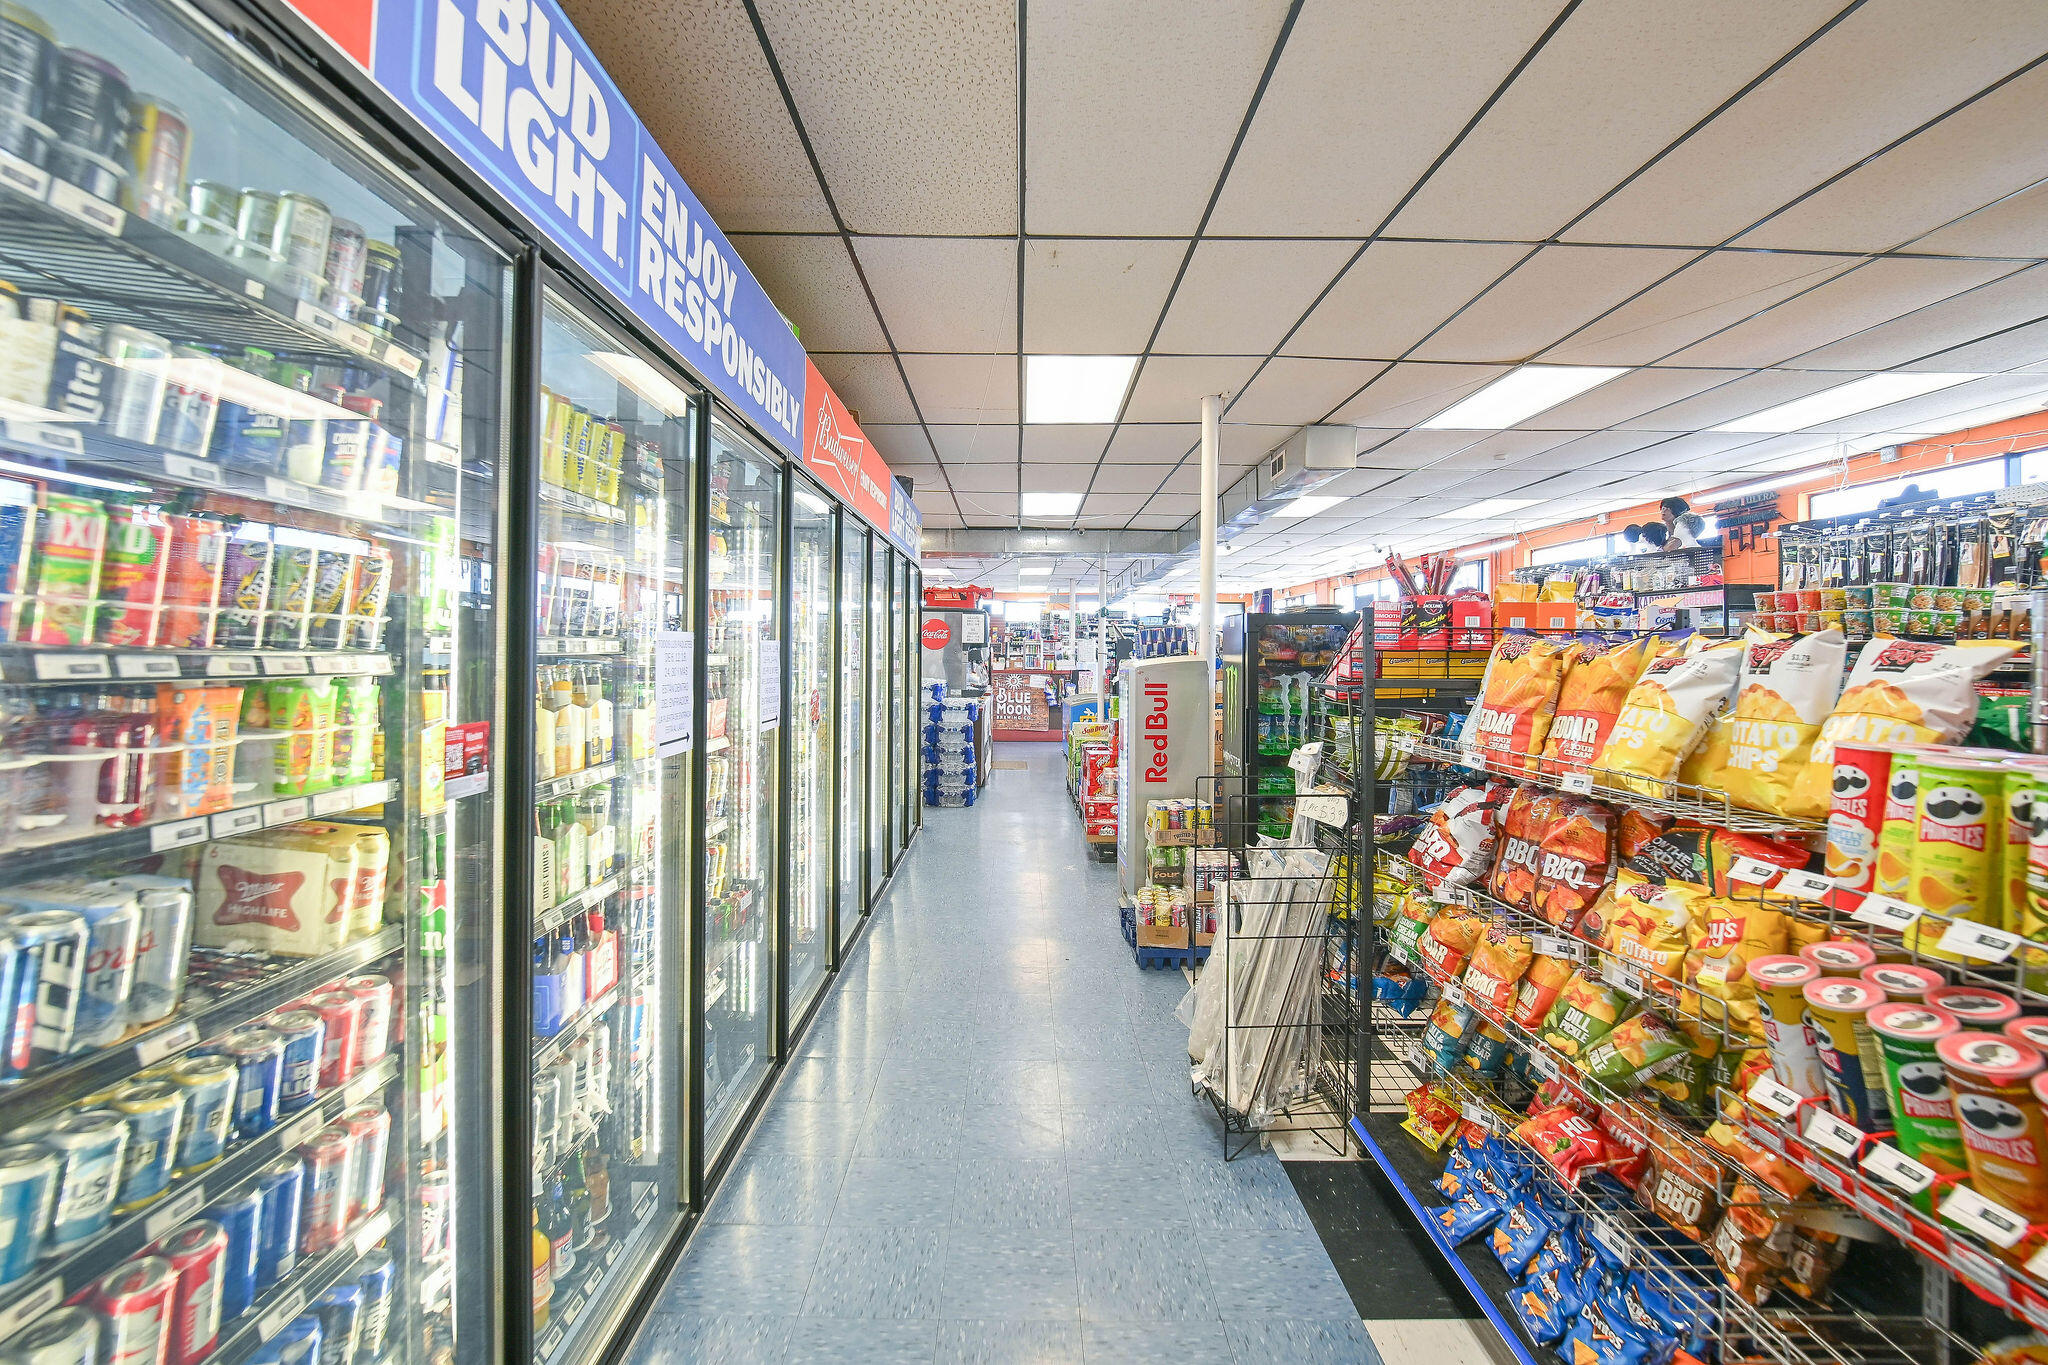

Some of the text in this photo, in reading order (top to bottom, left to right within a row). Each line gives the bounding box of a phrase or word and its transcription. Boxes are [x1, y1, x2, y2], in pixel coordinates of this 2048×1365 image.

[434, 0, 627, 267] LIGHT
[643, 152, 739, 319] ENJOY
[638, 221, 801, 440] RESPONSIBLY
[818, 407, 859, 476] Budweiser
[996, 704, 1032, 716] MOON
[1144, 683, 1169, 783] Red Bull
[1563, 749, 1593, 759] CREAM
[1920, 819, 1985, 850] PRINGLES
[1652, 836, 1670, 849] ON
[1667, 842, 1693, 867] THE
[1542, 851, 1592, 889] BBQ
[235, 881, 286, 903] Miller
[228, 903, 289, 919] HIGH LIFE
[1619, 936, 1669, 966] POTATO
[1559, 1020, 1590, 1044] PICKLE
[1564, 1006, 1593, 1032] DILL
[1656, 1180, 1703, 1226] BBQ
[1580, 1301, 1625, 1351] Doritos
